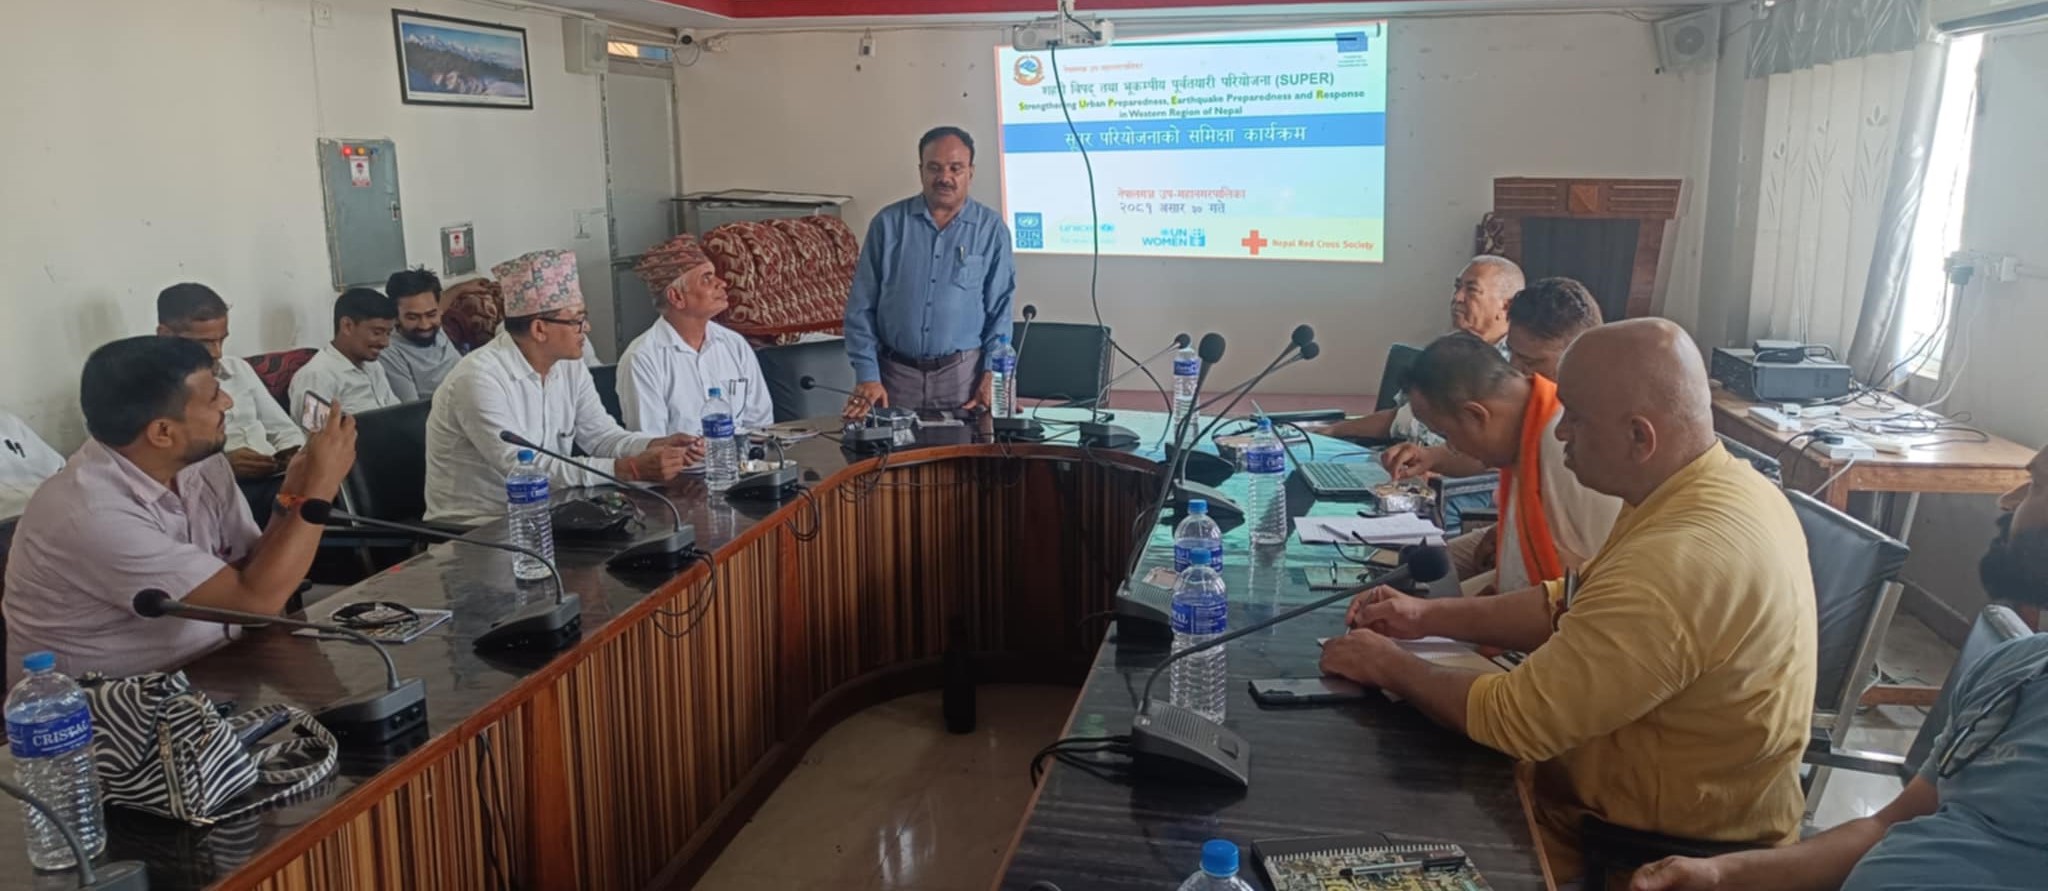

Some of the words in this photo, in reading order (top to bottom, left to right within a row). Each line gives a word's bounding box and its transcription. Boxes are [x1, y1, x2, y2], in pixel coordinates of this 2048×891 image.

[1100, 81, 1118, 93] तथा
[1221, 72, 1271, 89] परियोजना
[1275, 72, 1334, 88] (SUPER)
[1018, 101, 1077, 113] Strengthening
[1078, 98, 1106, 109] Urban
[1171, 94, 1223, 107] Earthquake
[1226, 92, 1292, 105] Preparedness
[1295, 90, 1313, 100] and
[1316, 89, 1365, 102] Response
[1119, 109, 1127, 118] in
[1129, 109, 1167, 118] Western
[1169, 107, 1200, 119] Region
[1203, 106, 1213, 116] of
[1214, 106, 1243, 118] Nepal
[1101, 124, 1181, 147] परियोजनाको
[1187, 123, 1235, 144] समिक्षा
[1243, 121, 1308, 142] कार्यक्रम
[1120, 202, 1152, 214] २०८१
[1209, 199, 1226, 213] गते
[1170, 228, 1187, 236] UN
[1142, 237, 1187, 246] WOMEN
[1272, 239, 1296, 249] Nepal
[1298, 239, 1314, 248] Red
[1316, 240, 1340, 249] Cross
[1343, 240, 1374, 250] Society
[32, 720, 89, 748] CRISTAL
